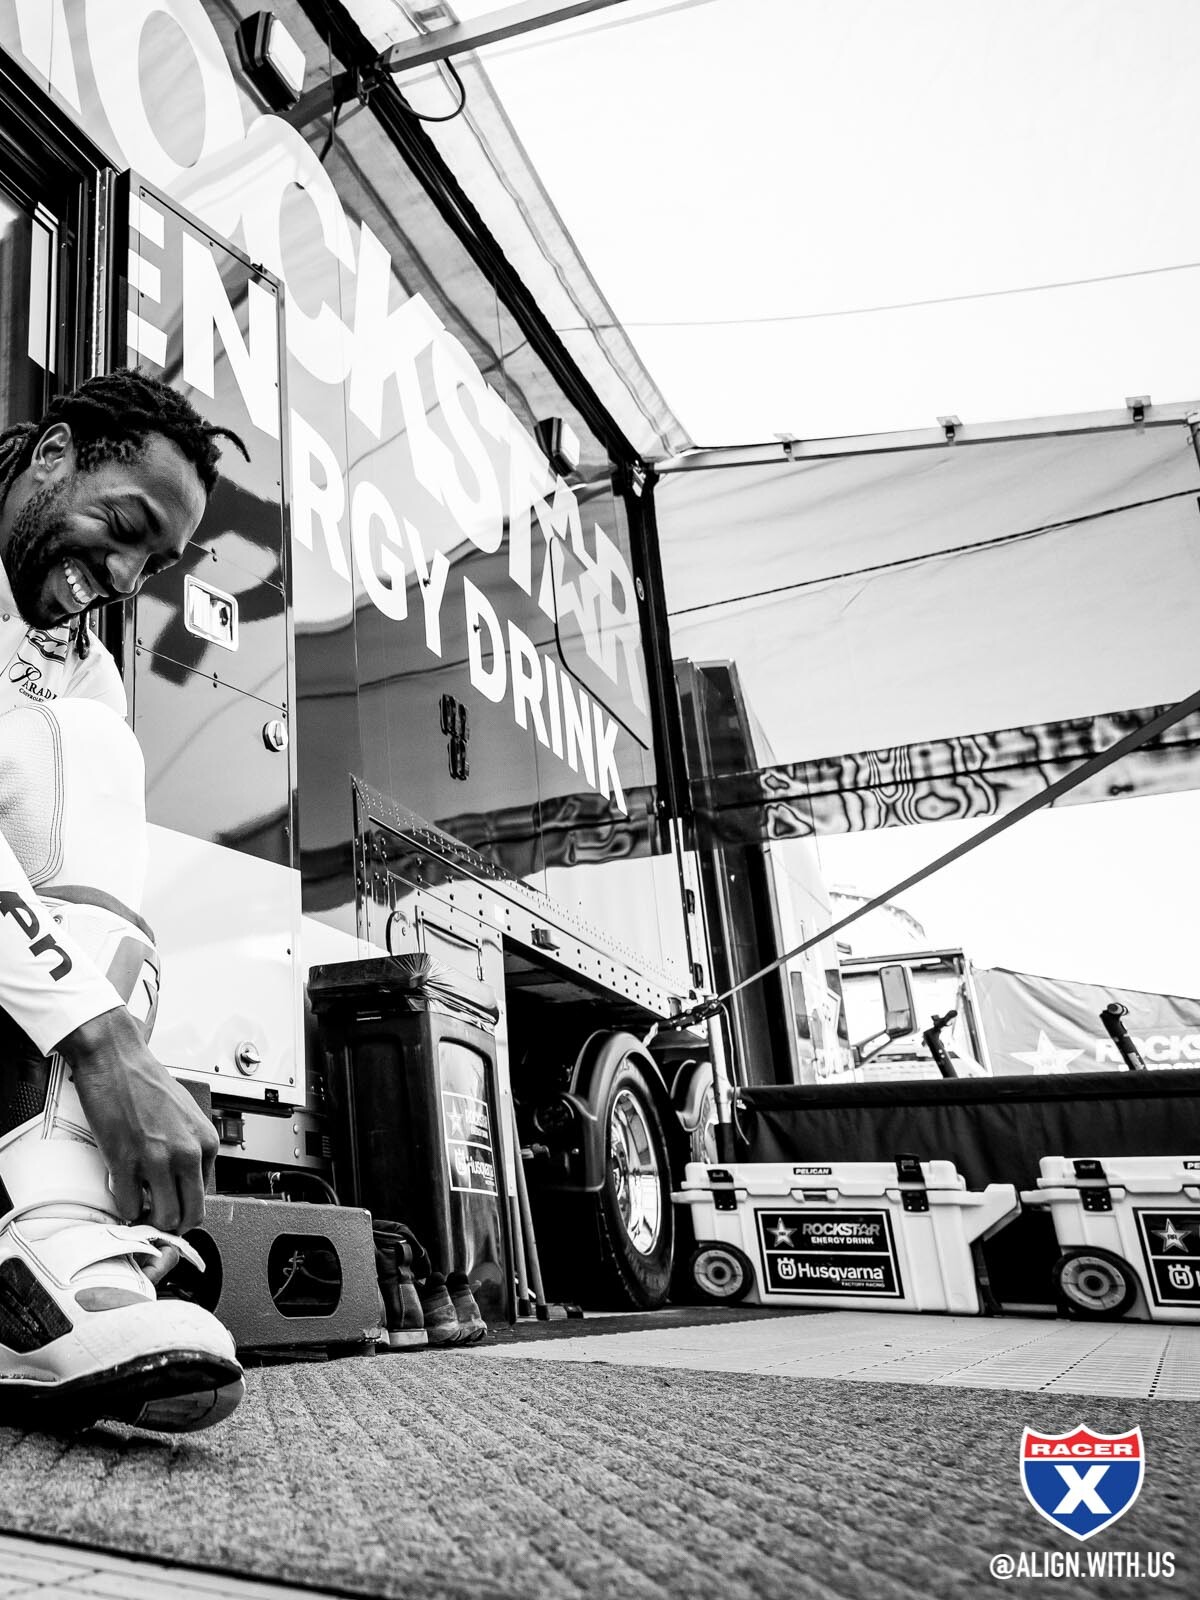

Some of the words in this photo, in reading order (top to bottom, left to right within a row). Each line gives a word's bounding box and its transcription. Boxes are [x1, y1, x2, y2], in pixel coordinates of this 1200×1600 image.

[15, 0, 648, 717] OCKSTAR
[463, 575, 629, 818] DRINK
[802, 1222, 881, 1236] ROCKSTAR
[811, 1236, 845, 1245] ENERGY
[846, 1237, 874, 1245] DRINK
[797, 1262, 884, 1281] Husqvarna
